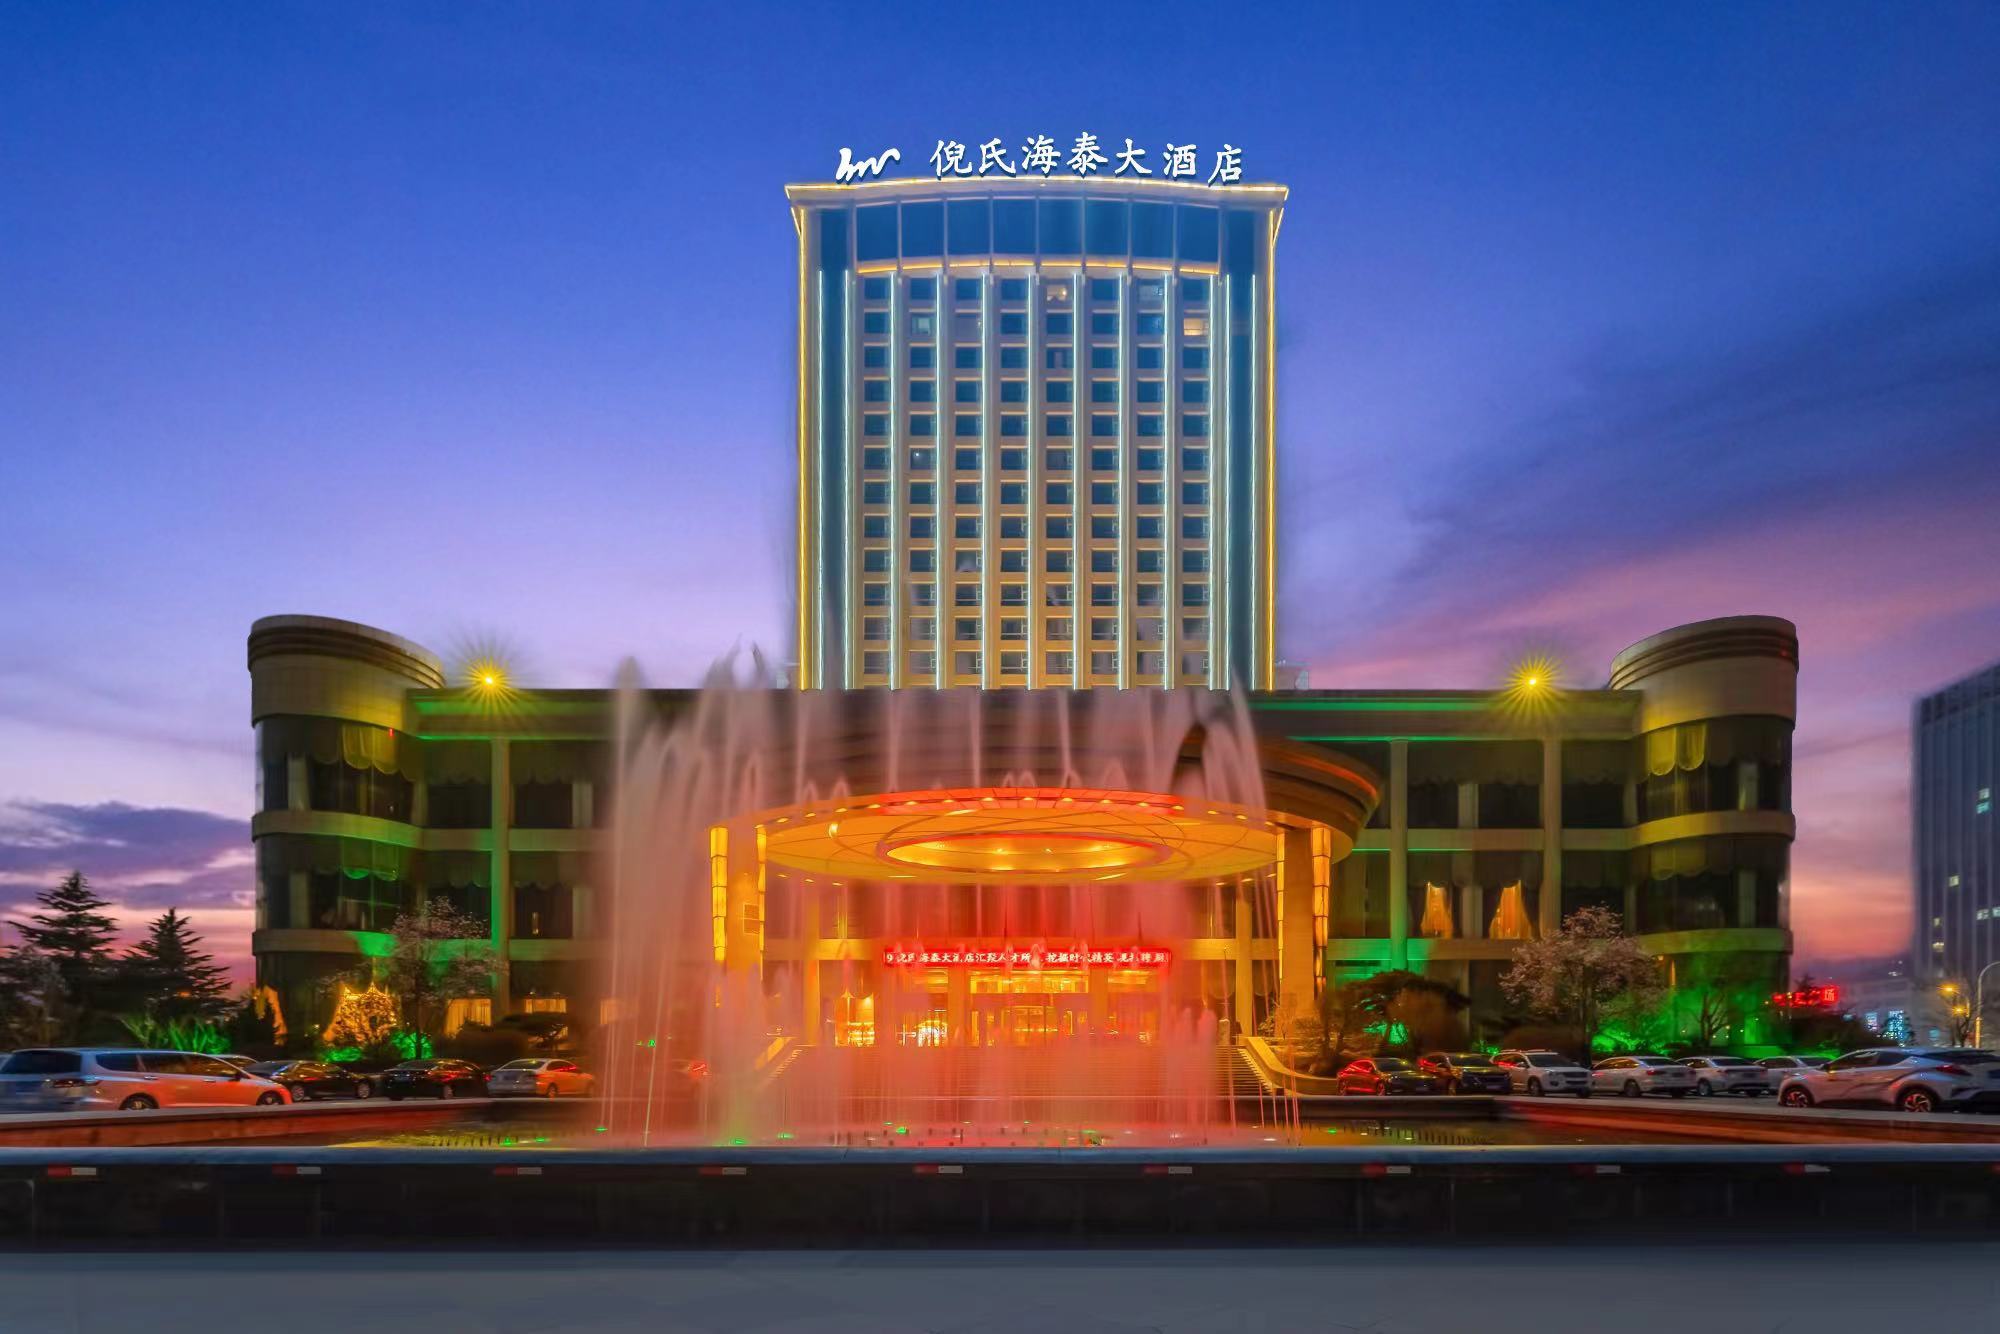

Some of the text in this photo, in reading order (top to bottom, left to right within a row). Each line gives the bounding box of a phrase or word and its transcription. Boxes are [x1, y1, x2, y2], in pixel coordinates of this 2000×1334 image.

[930, 131, 1242, 184] 倪氏海泰大酒店
